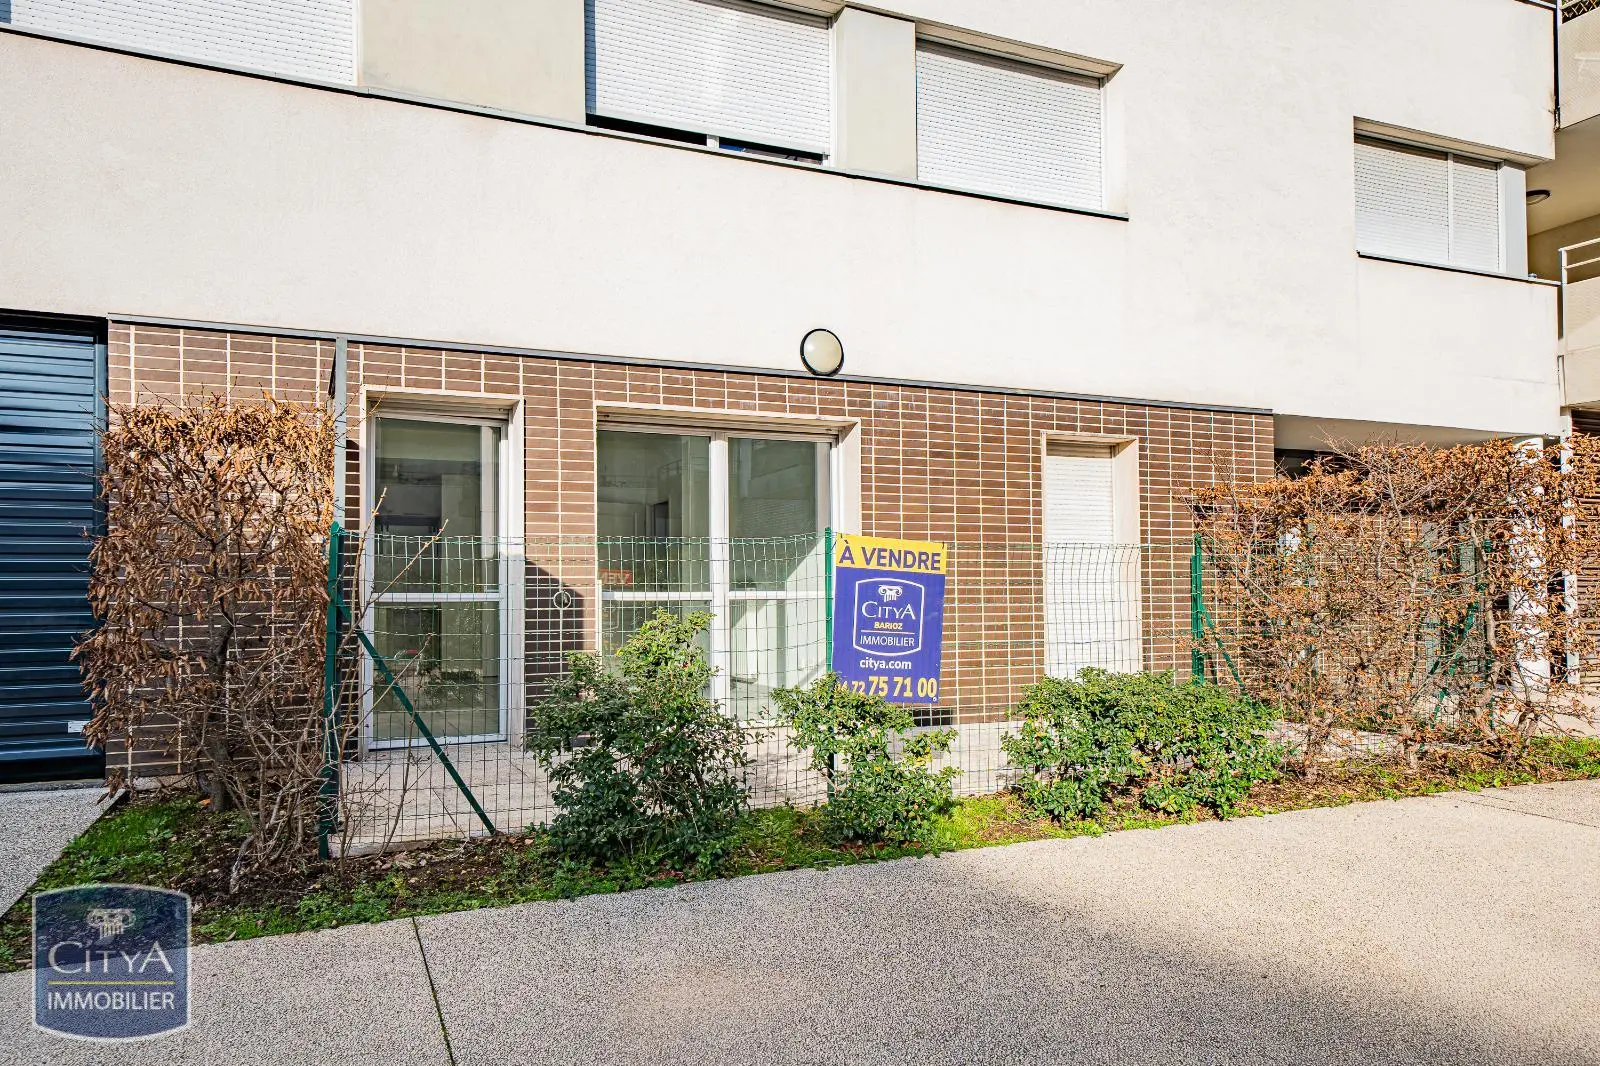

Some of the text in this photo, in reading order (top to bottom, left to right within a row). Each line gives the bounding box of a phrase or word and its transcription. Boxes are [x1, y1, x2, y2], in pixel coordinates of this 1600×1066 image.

[838, 539, 941, 570] À VENDRE
[873, 621, 903, 630] BARIOZ
[860, 635, 915, 647] IMMOBILIER
[859, 657, 912, 670] citya.com
[868, 675, 888, 697] 75
[893, 676, 913, 698] 71
[917, 677, 938, 698] 00
